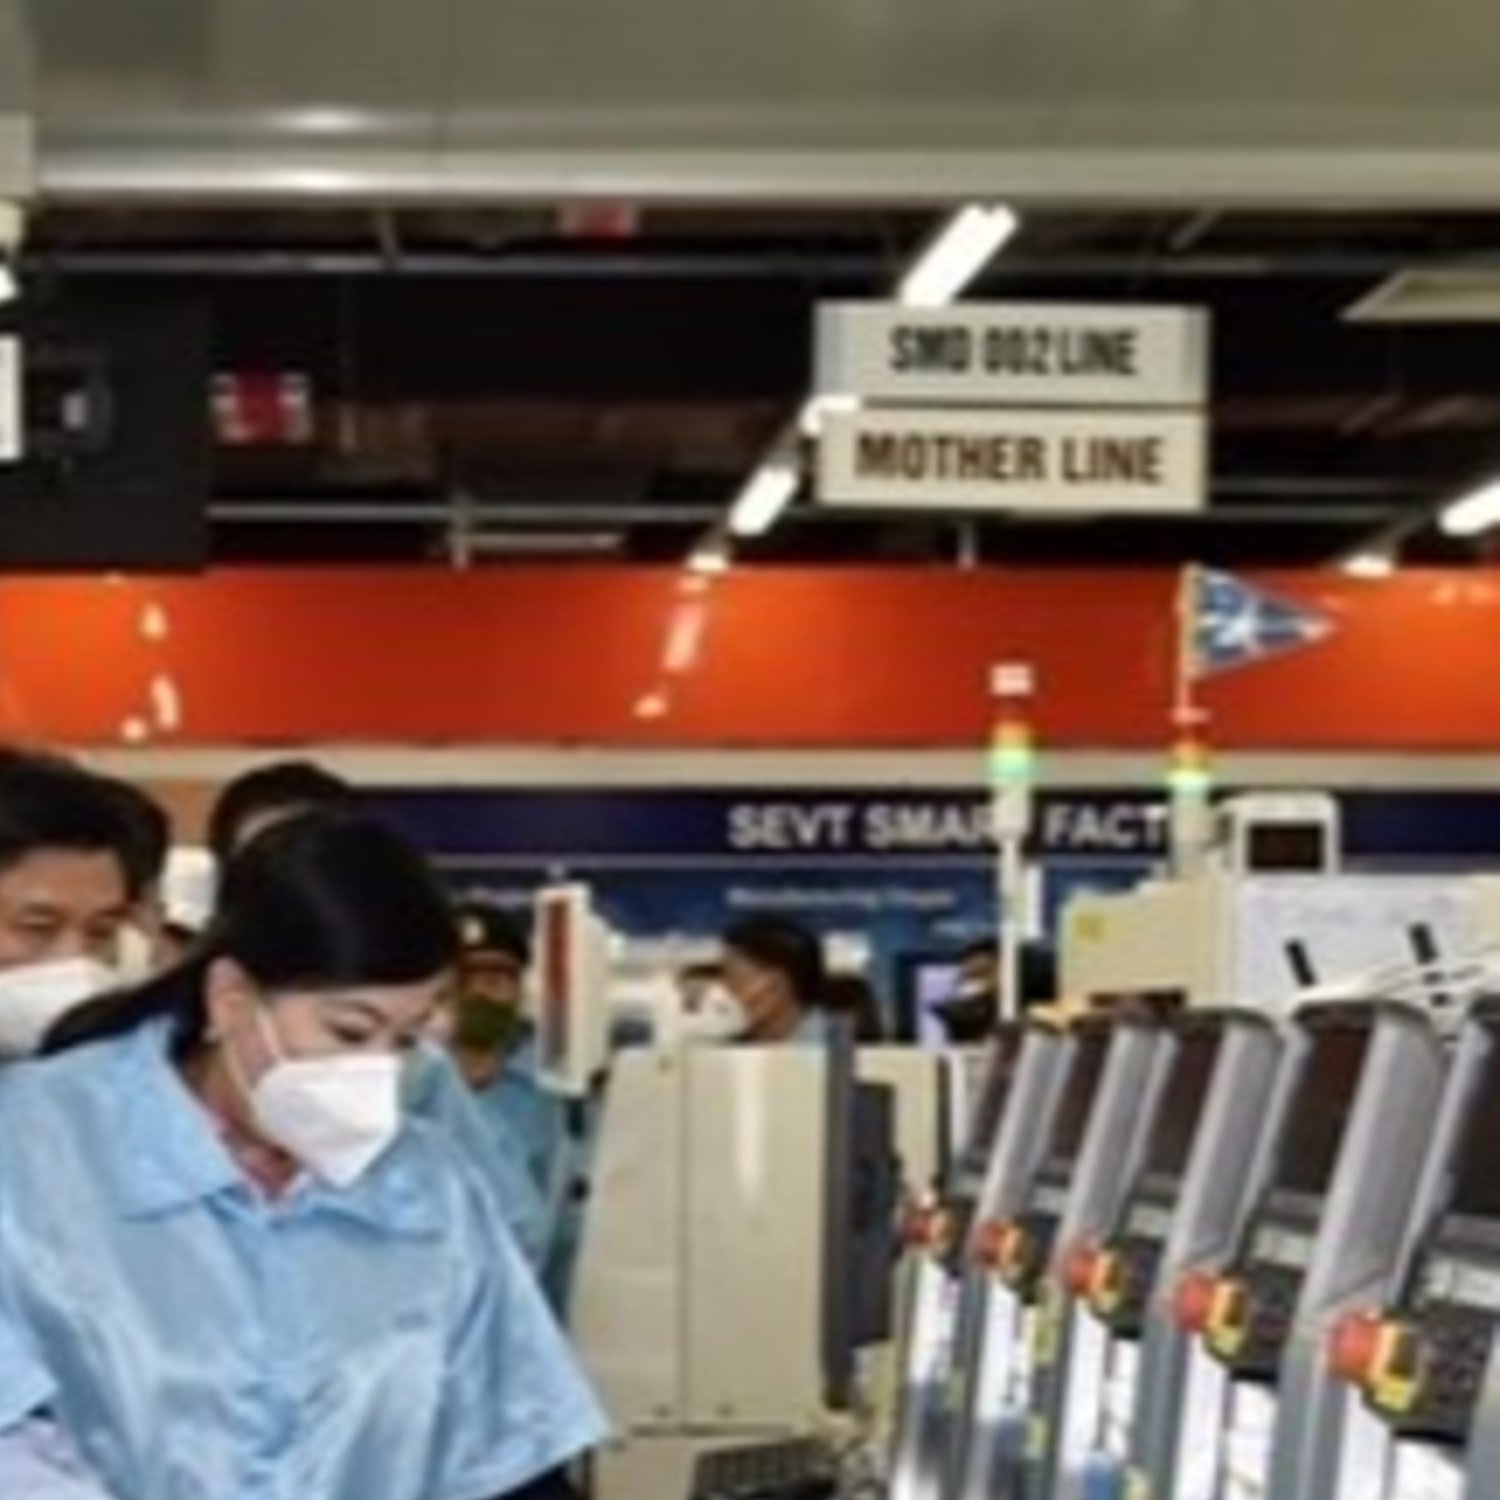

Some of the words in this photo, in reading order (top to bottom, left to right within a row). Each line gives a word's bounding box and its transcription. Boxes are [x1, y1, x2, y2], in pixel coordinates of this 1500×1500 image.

[1061, 328, 1138, 377] LINE
[854, 430, 1047, 482] MOTHER
[1061, 434, 1165, 484] LINE
[727, 804, 854, 849] SEVT
[865, 804, 1002, 849] SMAR
[1045, 804, 1170, 847] FACT
